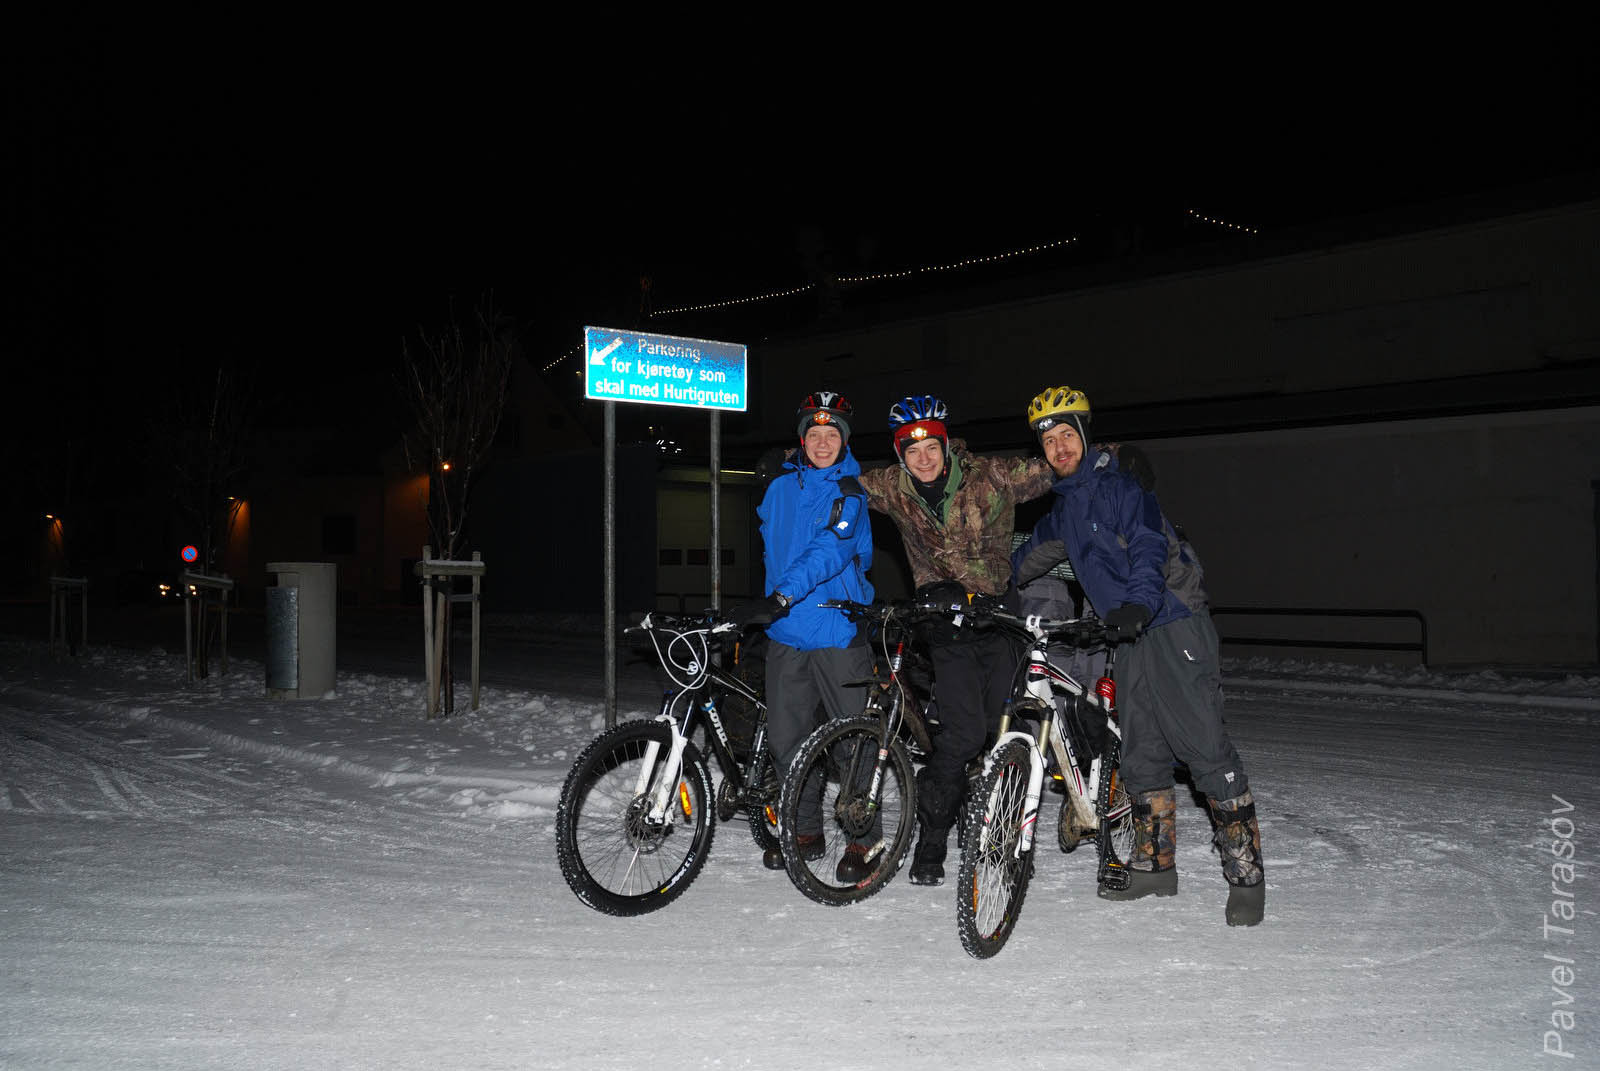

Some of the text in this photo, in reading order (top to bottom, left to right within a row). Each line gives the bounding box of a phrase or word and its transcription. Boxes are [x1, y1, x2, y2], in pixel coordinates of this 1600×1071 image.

[638, 338, 701, 363] Parkering
[611, 357, 726, 383] for kjøretøy som
[595, 378, 739, 405] skal med Hurtigruten
